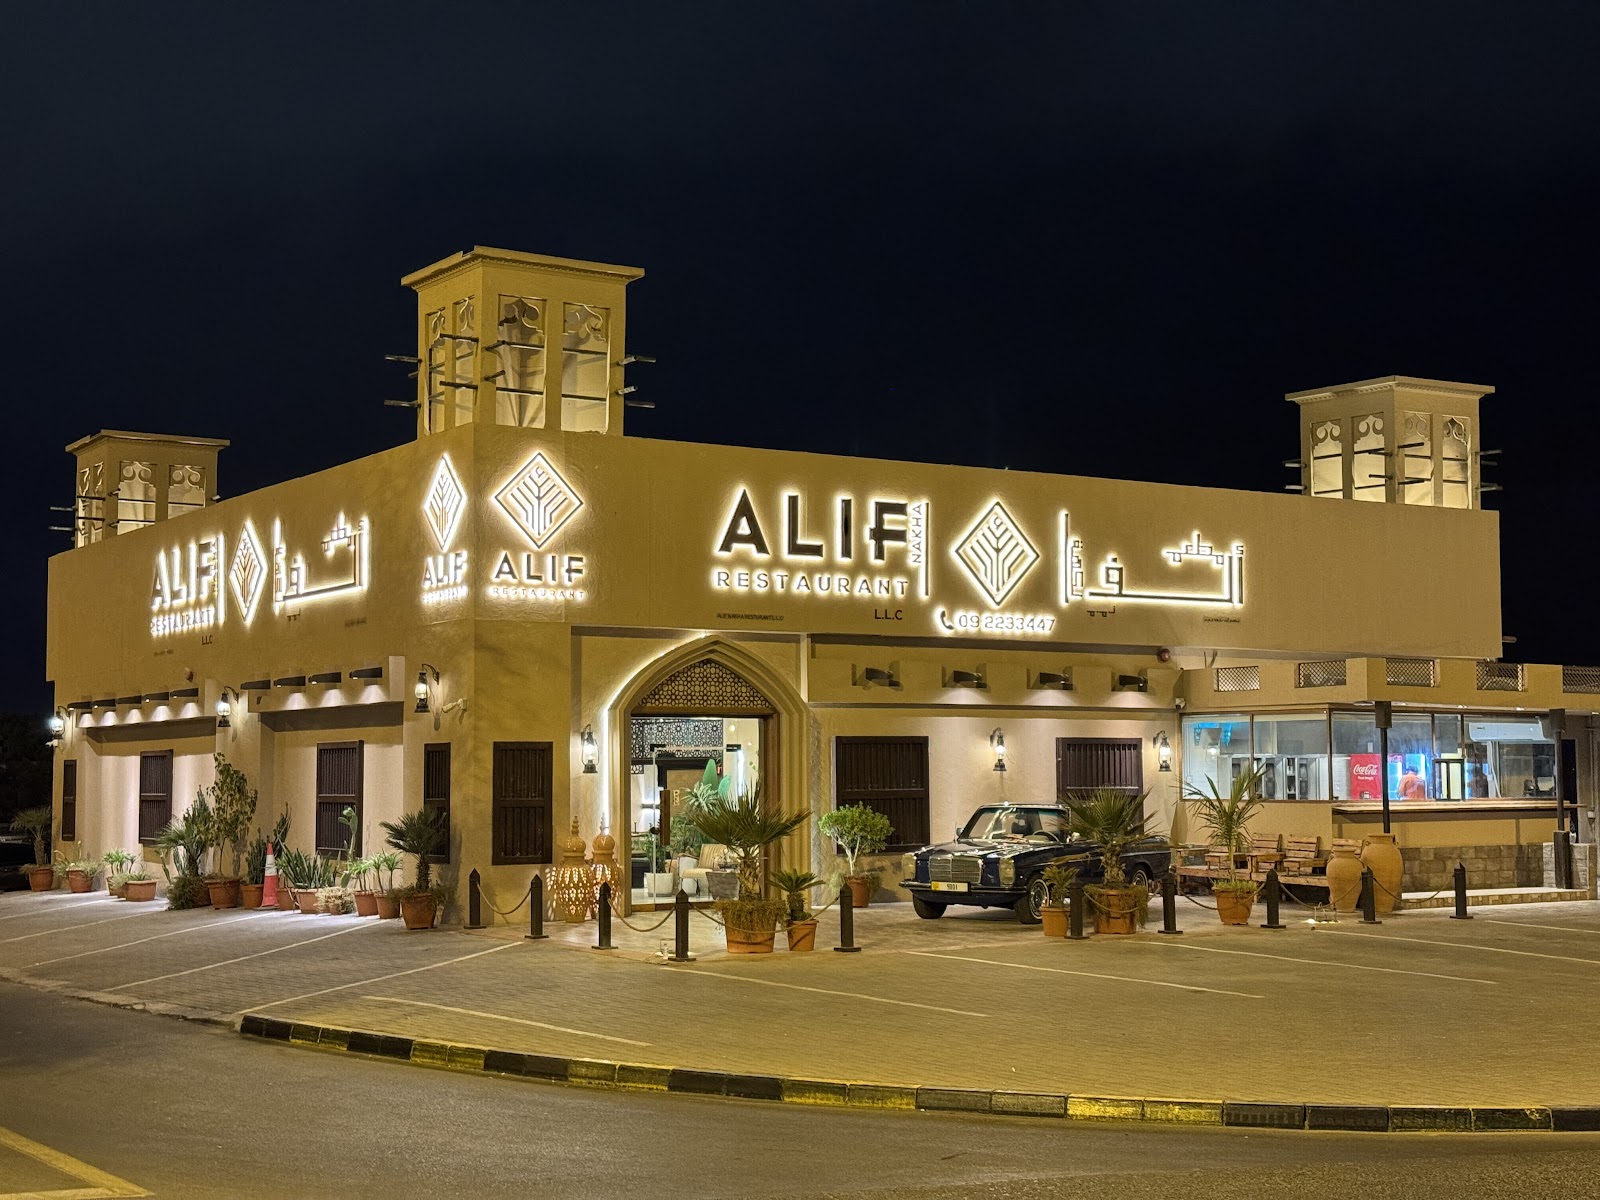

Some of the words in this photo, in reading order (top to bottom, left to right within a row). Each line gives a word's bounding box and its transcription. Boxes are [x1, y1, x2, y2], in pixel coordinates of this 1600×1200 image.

[718, 489, 908, 561] ALIF
[911, 503, 923, 564] NAKHA
[151, 541, 212, 608] ALIF
[422, 552, 464, 586] ALIF
[494, 552, 584, 583] ALIF
[493, 587, 585, 599] RESTAURANT
[717, 571, 909, 596] RESTAURANT
[151, 609, 211, 634] RESTAURANT
[874, 608, 904, 621] L.L.C
[959, 614, 980, 628] 09
[984, 615, 1056, 631] 2233447
